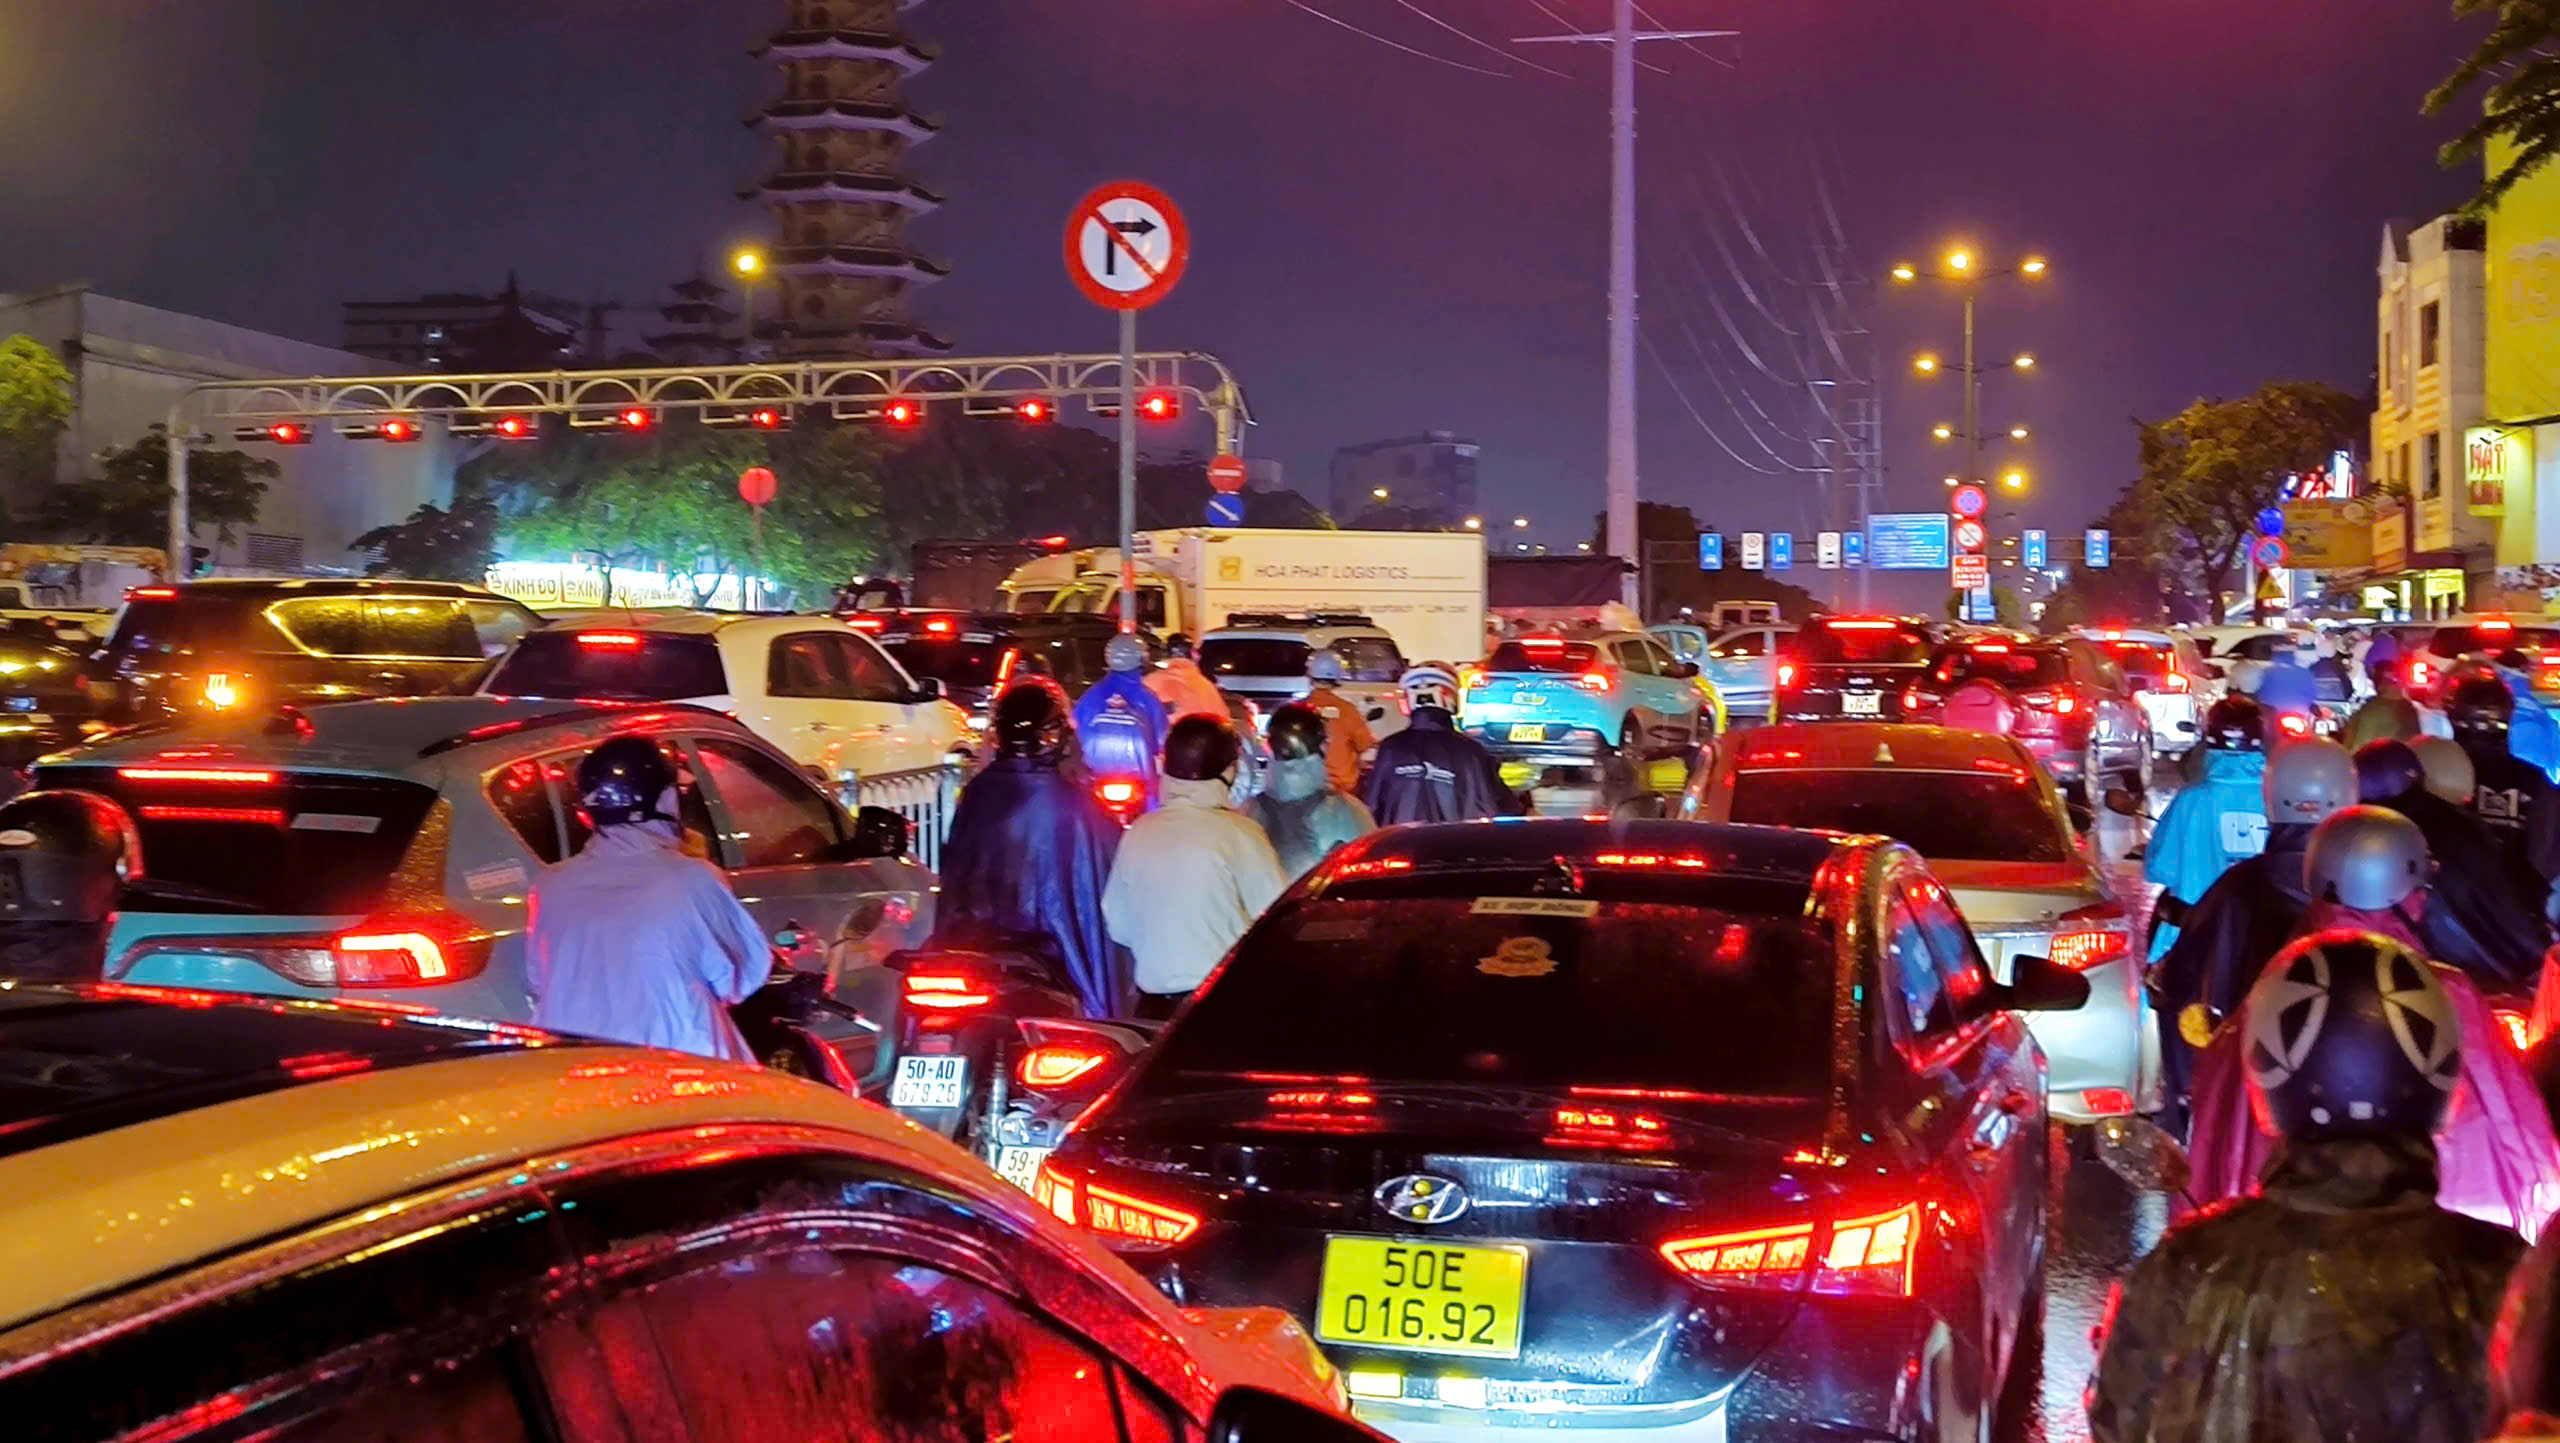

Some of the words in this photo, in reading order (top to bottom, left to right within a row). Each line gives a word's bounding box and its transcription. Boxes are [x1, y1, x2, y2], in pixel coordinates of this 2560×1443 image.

[1333, 566, 1409, 580] LOGISTICS
[907, 1060, 955, 1080] 50-AD
[1384, 1248, 1465, 1292] 50E
[1344, 1294, 1496, 1345] 016.92
